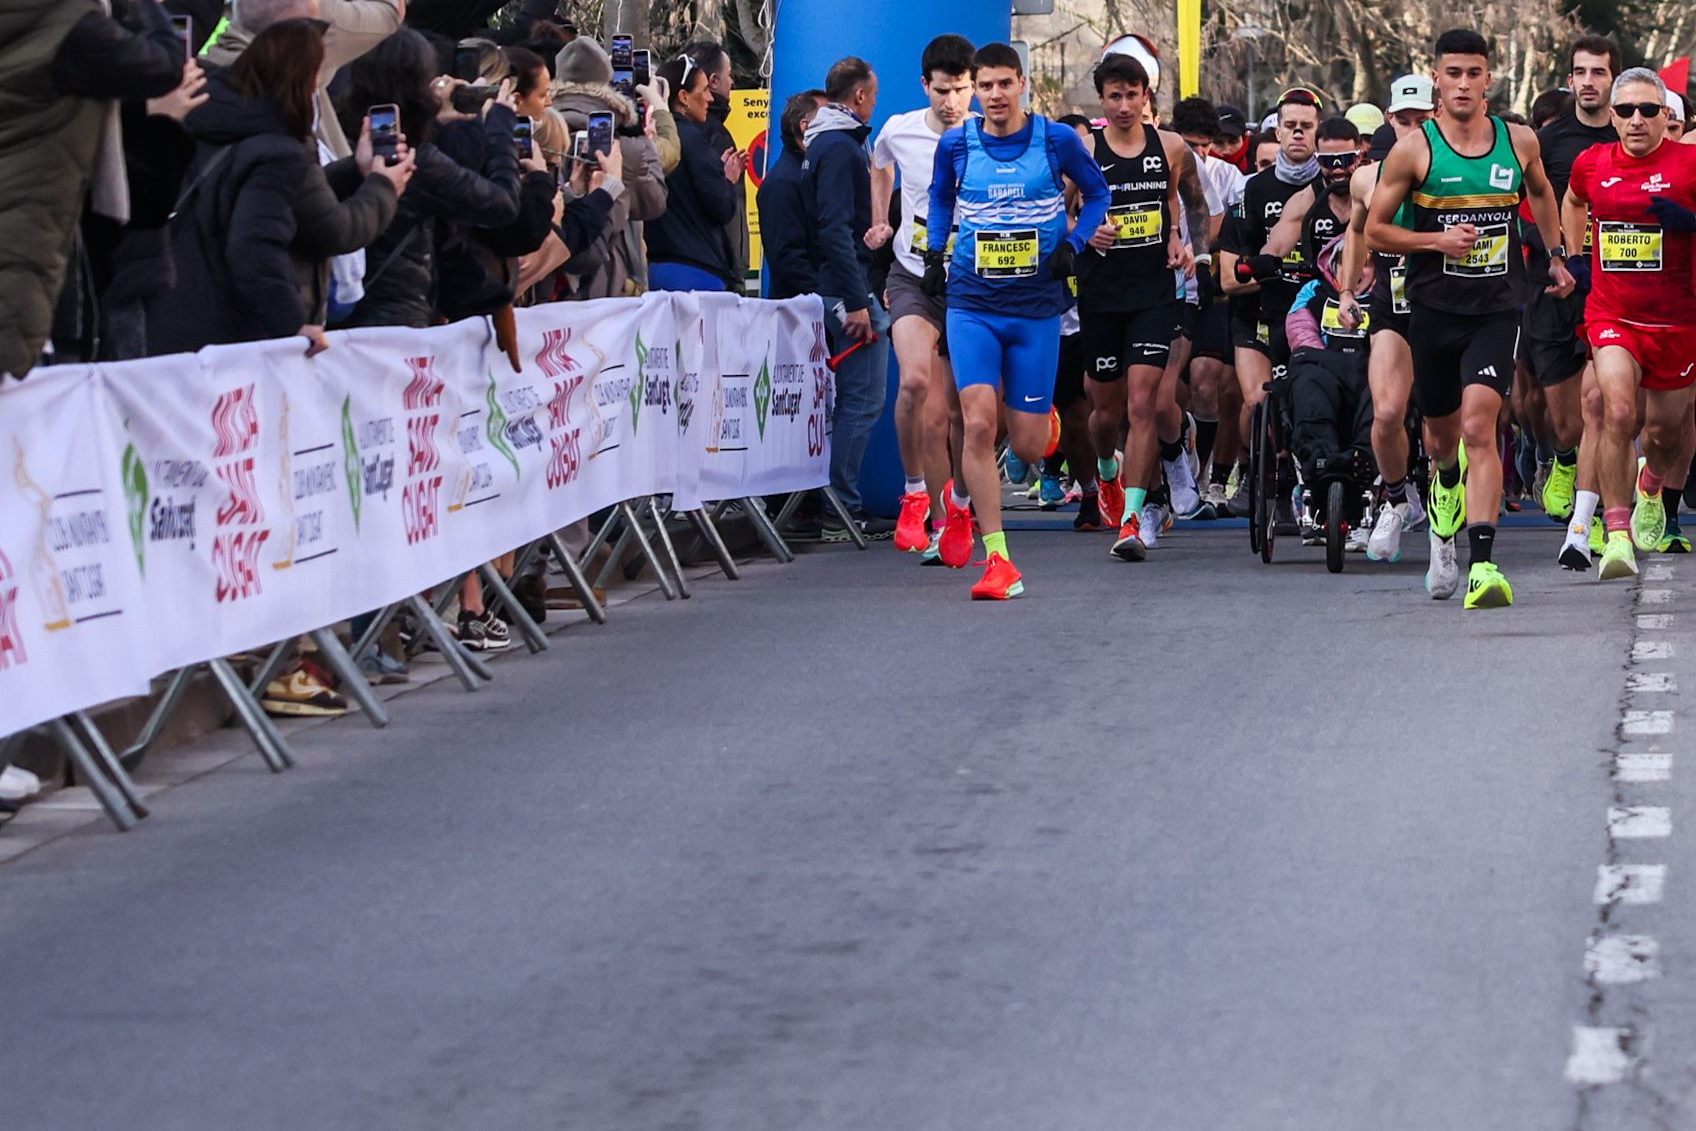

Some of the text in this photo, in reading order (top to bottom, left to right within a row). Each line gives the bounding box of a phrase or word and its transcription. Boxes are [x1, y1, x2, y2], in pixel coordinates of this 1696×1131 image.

[1123, 214, 1148, 225] DAVID
[1437, 211, 1512, 224] CERDANYOLA
[1129, 226, 1145, 236] 946
[1607, 234, 1651, 245] ROBERTO
[982, 242, 1031, 253] FRANCESC
[1619, 248, 1637, 258] 700
[997, 256, 1015, 265] 692
[1466, 253, 1489, 264] 2543
